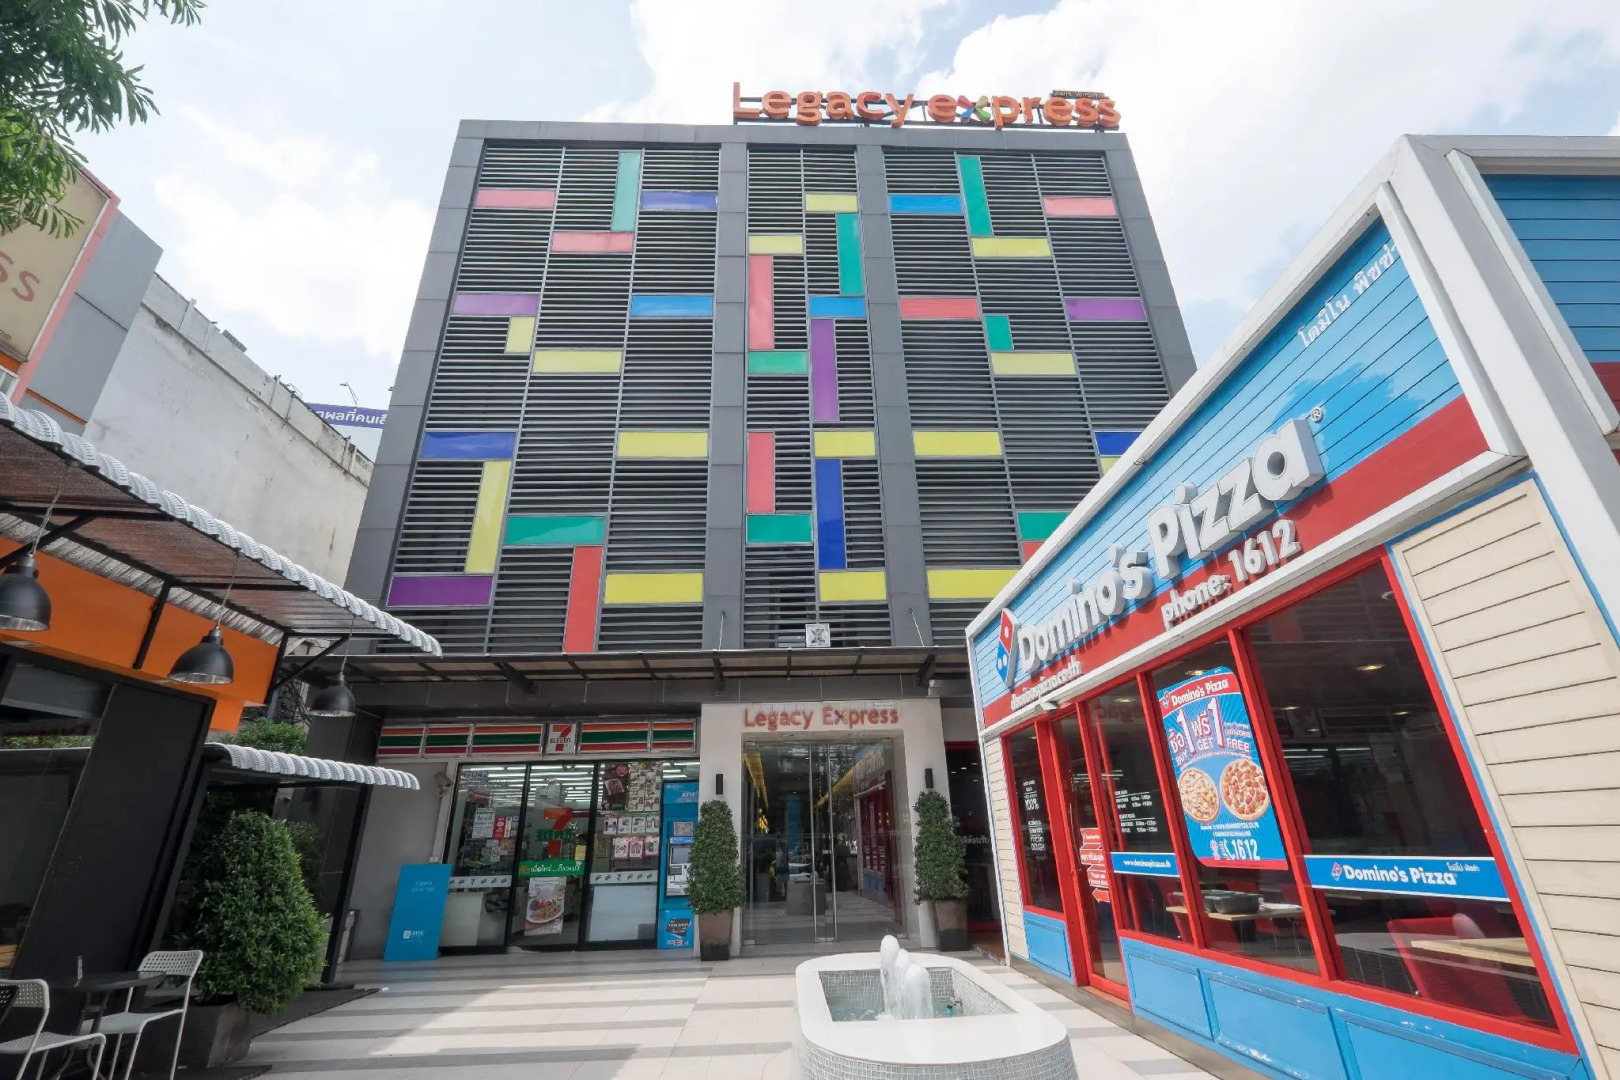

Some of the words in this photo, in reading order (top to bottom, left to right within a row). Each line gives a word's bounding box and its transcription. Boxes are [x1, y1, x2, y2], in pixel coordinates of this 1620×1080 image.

[733, 82, 913, 128] Legacy
[928, 92, 1121, 131] express
[1297, 295, 1351, 347] โดมิโน
[1353, 243, 1396, 295] พิซซ่
[1016, 543, 1153, 675] Domino's
[1147, 417, 1326, 579] Pizza
[1160, 573, 1232, 628] phone:
[1228, 519, 1302, 582] 1612
[1171, 686, 1205, 706] Domino's
[1205, 679, 1229, 695] Pizza
[744, 708, 814, 732] Legacy
[822, 705, 900, 729] Express
[1176, 708, 1197, 756] 1
[1207, 697, 1225, 748] 1
[1176, 751, 1189, 766] BUY
[1196, 738, 1214, 751] GET
[1226, 738, 1250, 753] FREE
[1342, 864, 1409, 883] Domino's
[1409, 866, 1457, 886] Pizza
